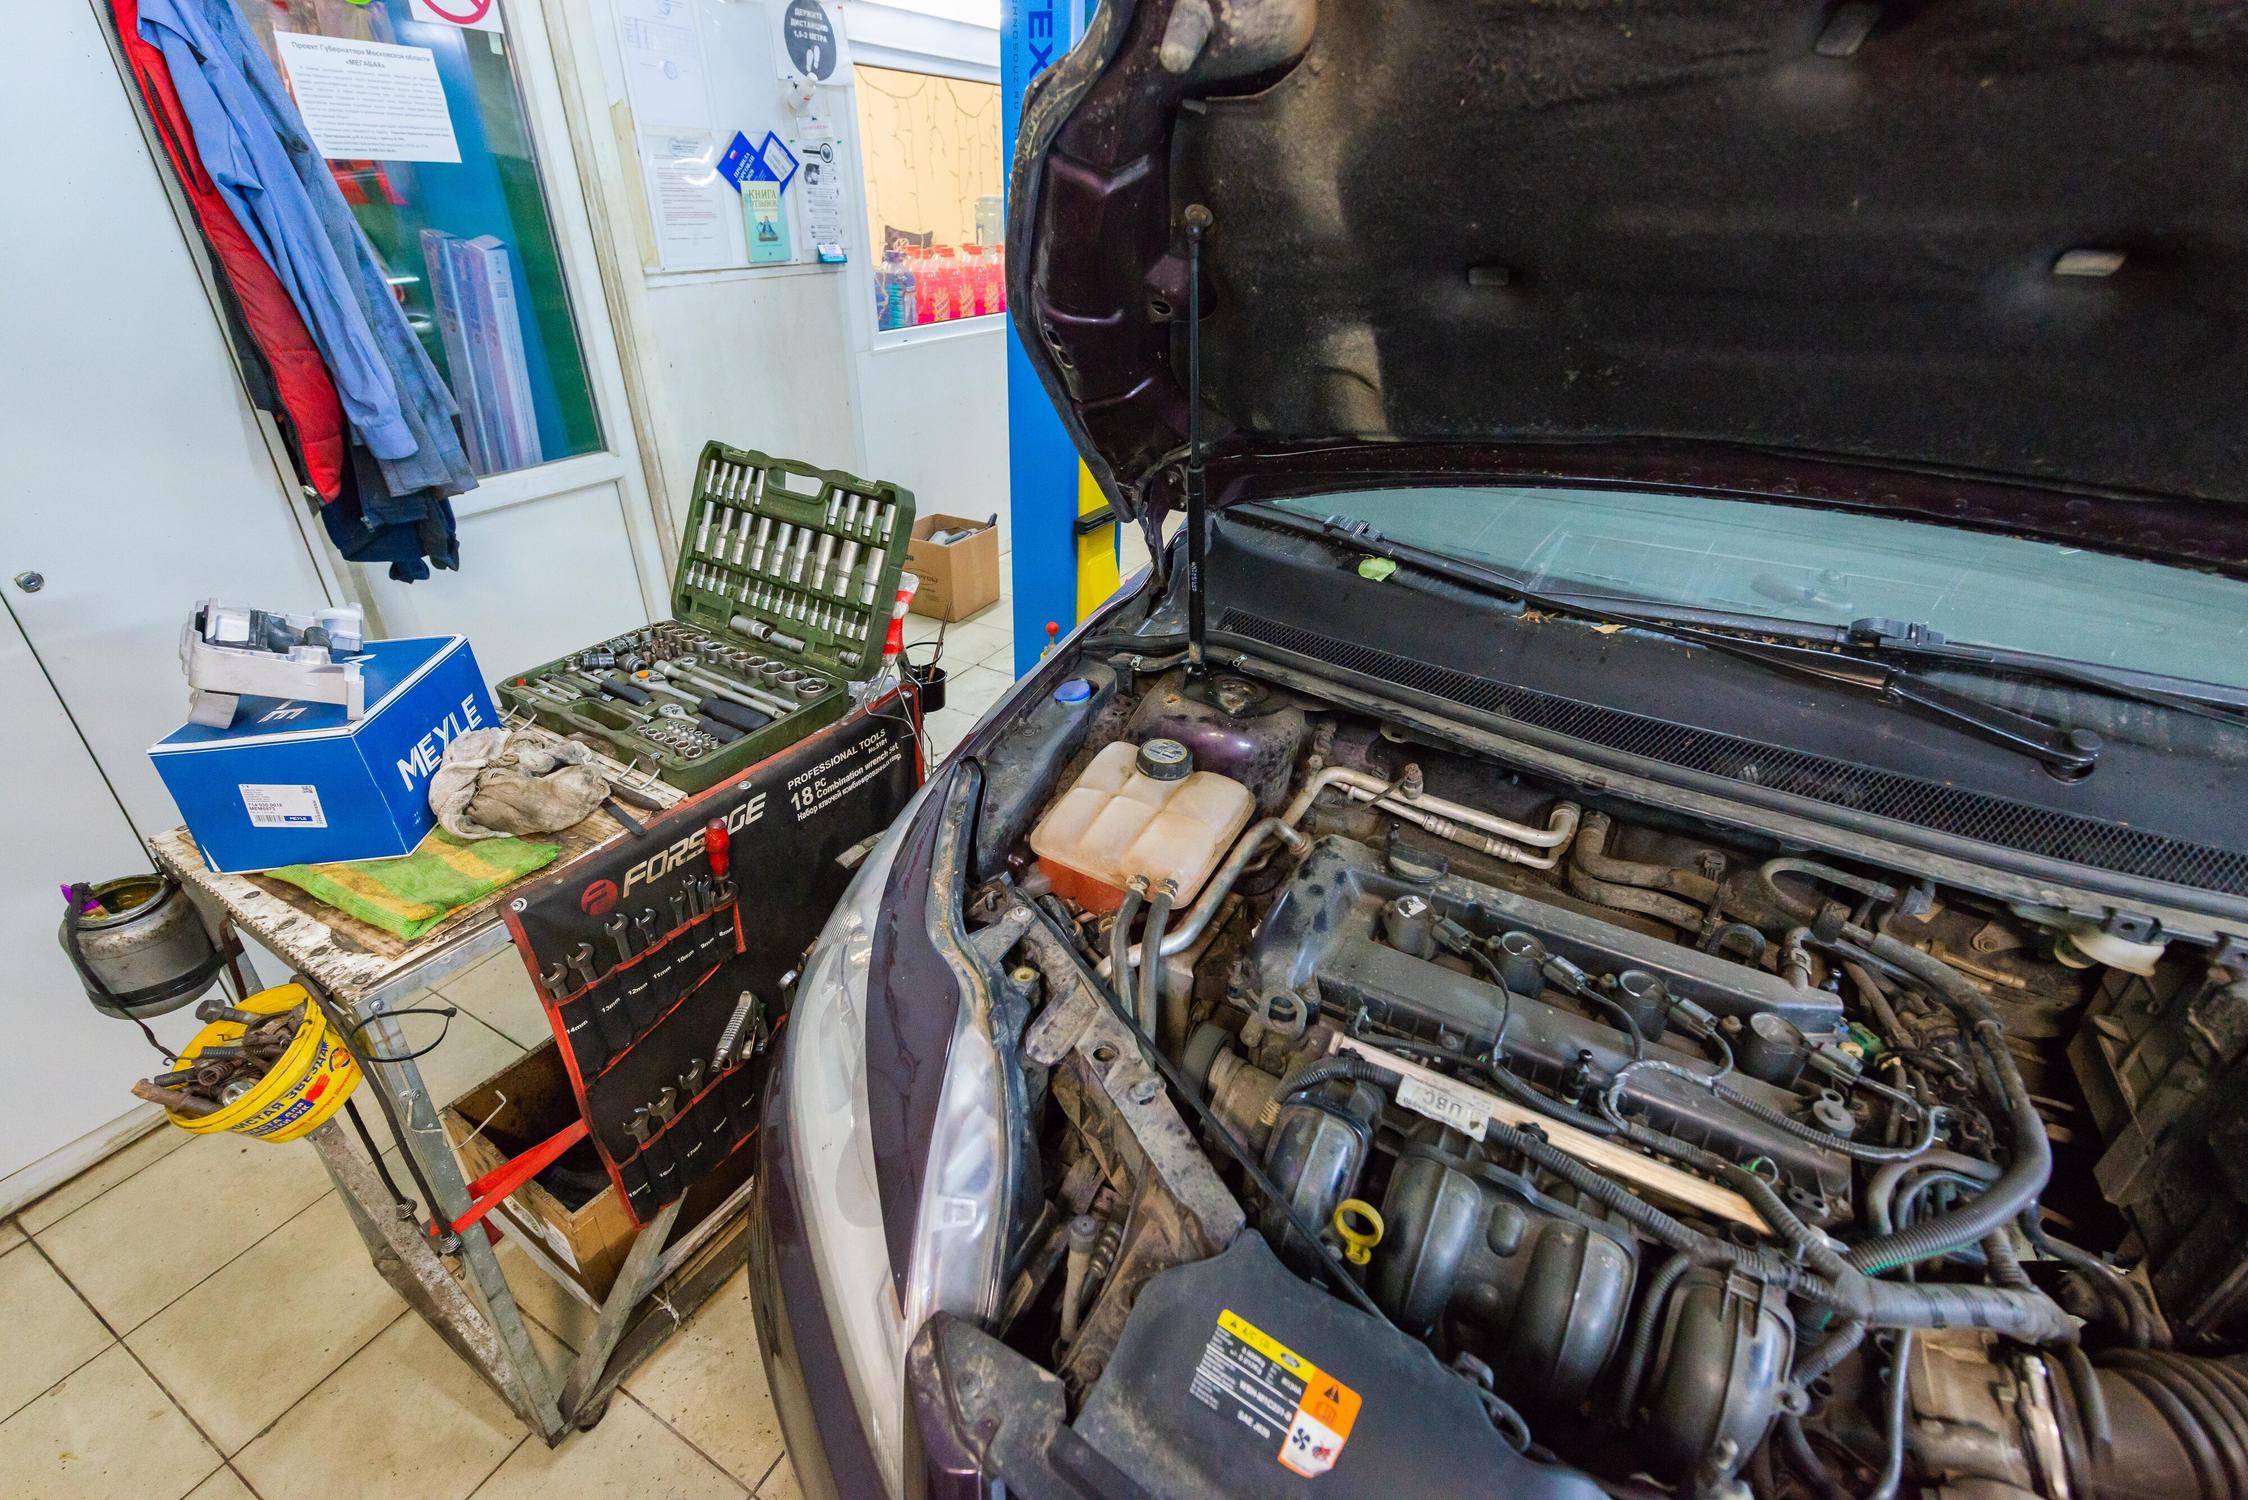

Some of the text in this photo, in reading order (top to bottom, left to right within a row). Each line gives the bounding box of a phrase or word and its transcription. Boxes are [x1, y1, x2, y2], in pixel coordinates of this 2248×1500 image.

[1028, 0, 1053, 79] EX
[748, 189, 777, 200] КНИГА
[396, 693, 483, 792] MEYLE
[787, 728, 886, 790] PROFESSIONAL TOOLS
[816, 742, 899, 798] Combination wrench set
[814, 777, 827, 791] PC
[790, 786, 814, 811] 18
[797, 804, 818, 821] Набор
[818, 790, 842, 809] ключей
[623, 792, 767, 898] FORSGE
[676, 949, 695, 963] 10mm
[652, 965, 672, 980] 11mm
[628, 982, 648, 996] 12mm
[601, 997, 621, 1013] 13mm
[566, 1019, 588, 1035] 14mm
[291, 1104, 311, 1121] РУК
